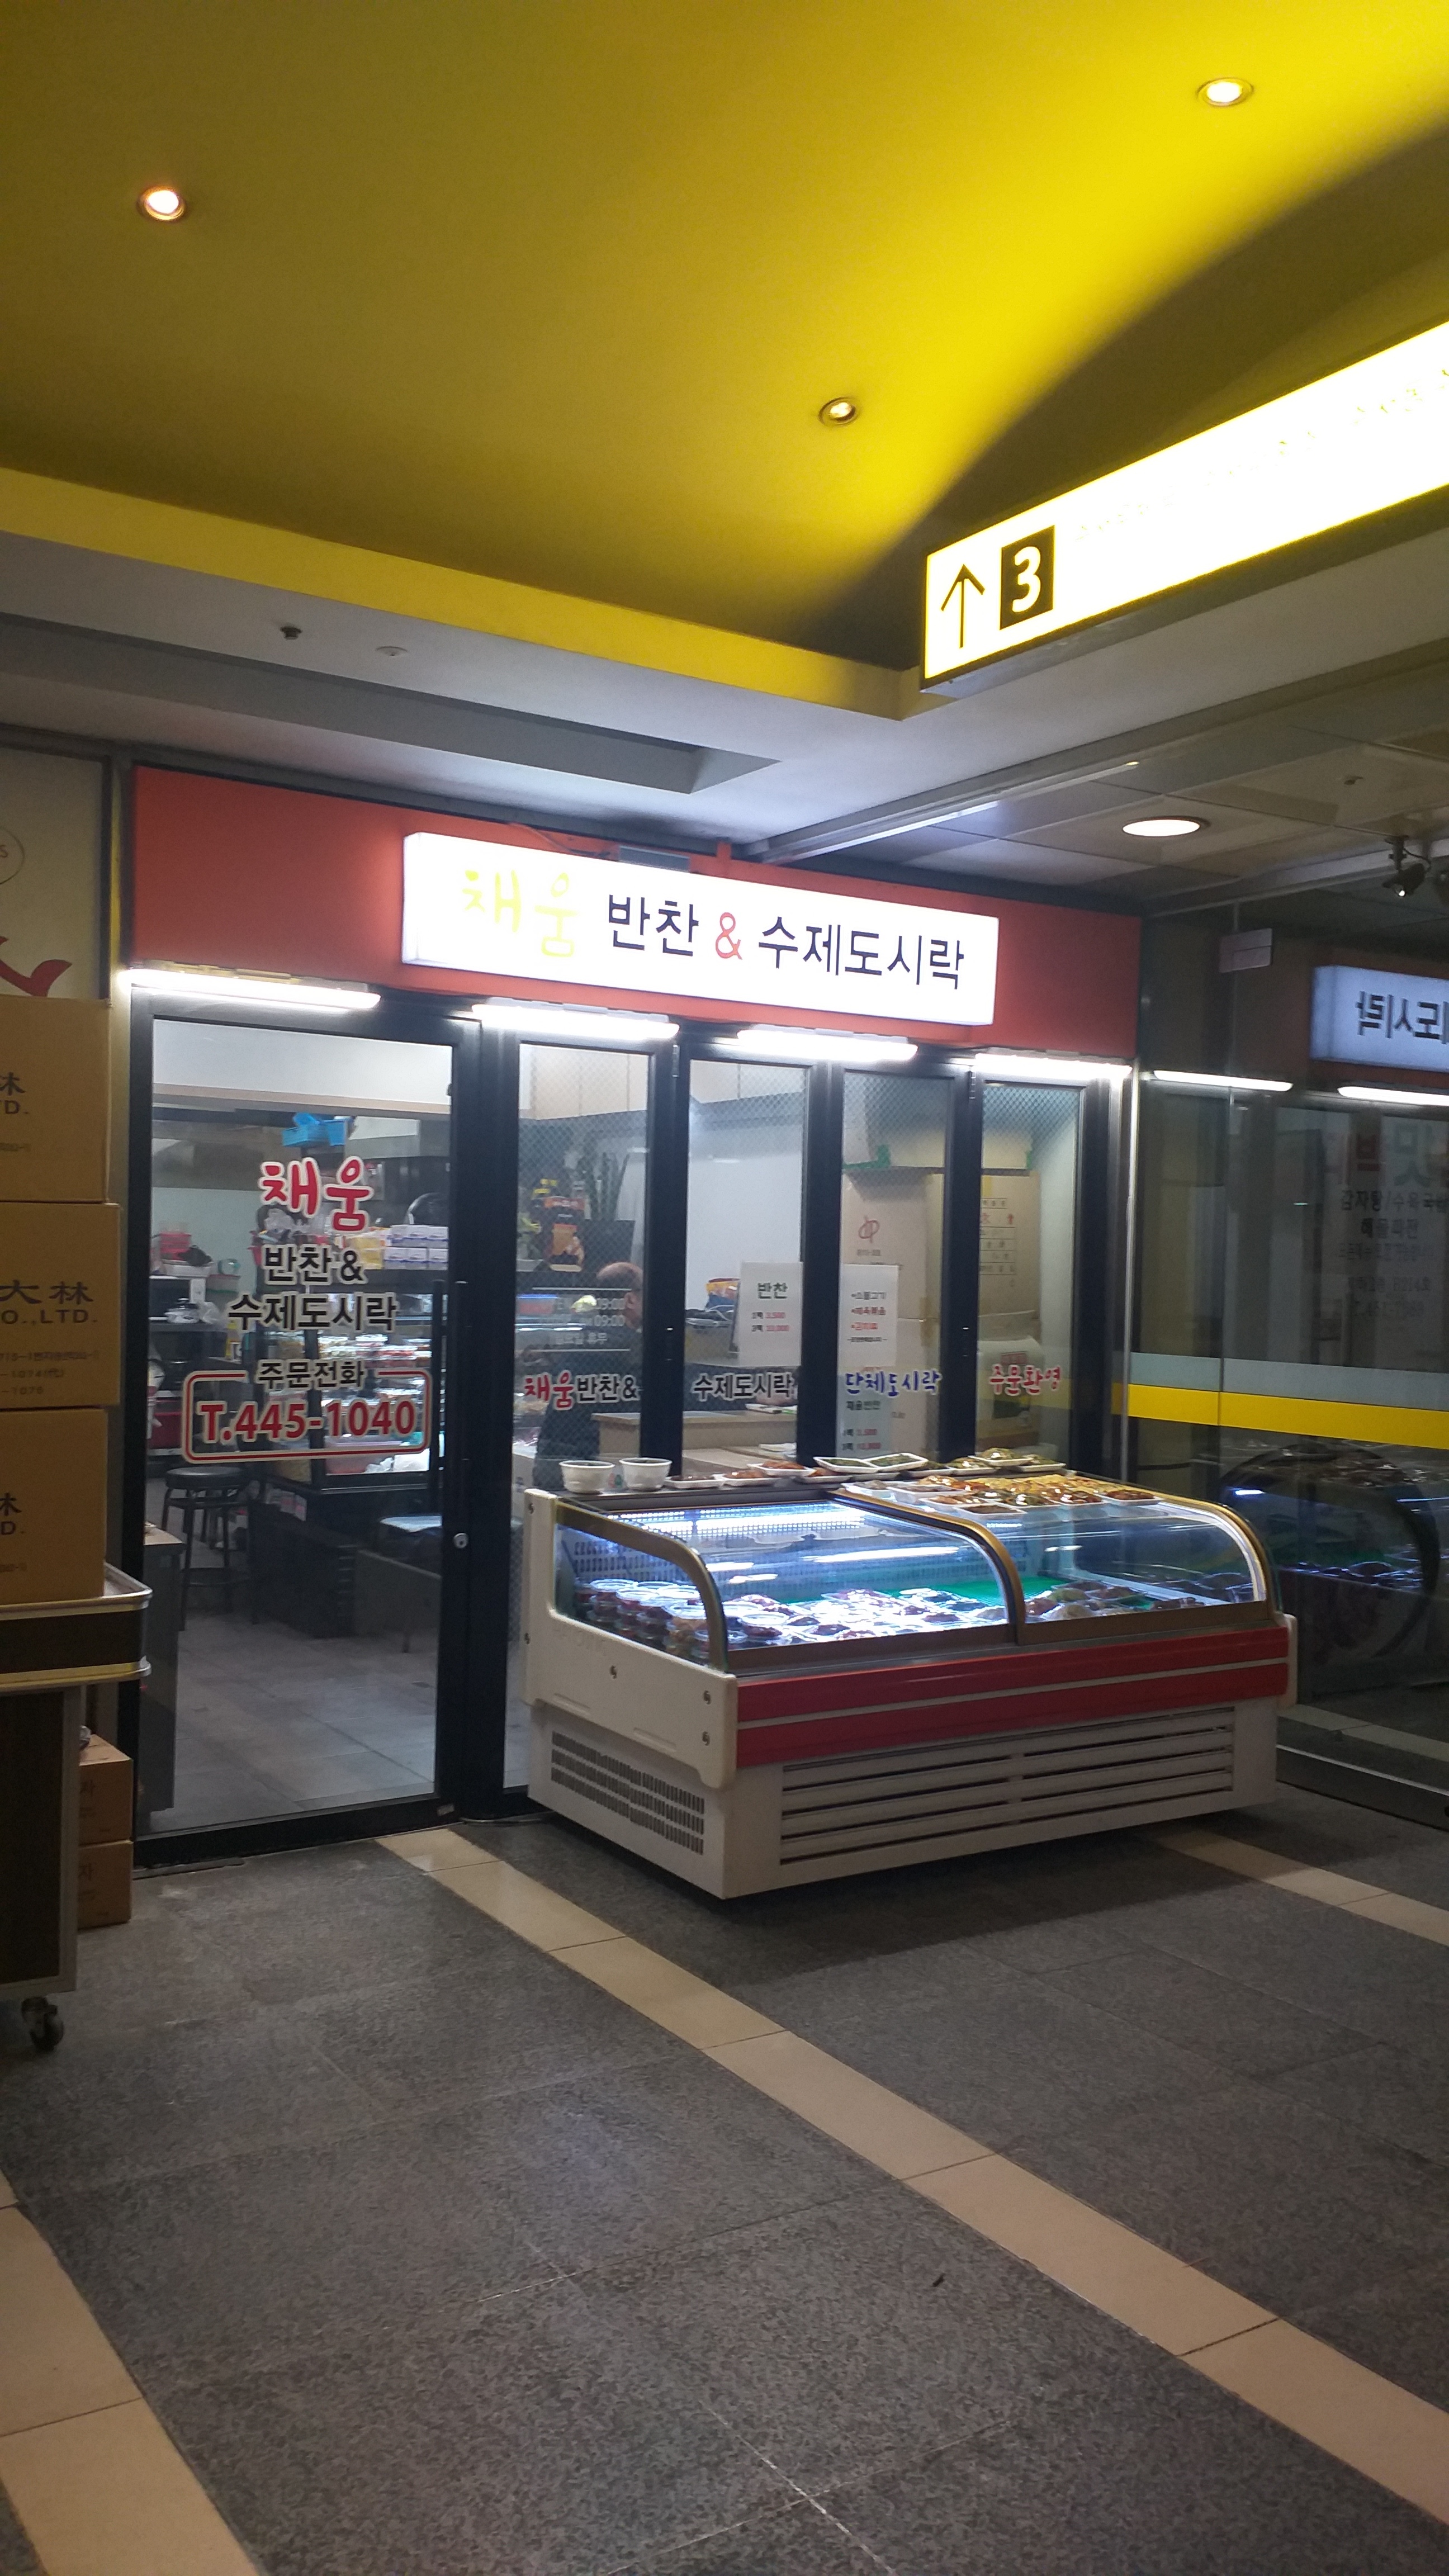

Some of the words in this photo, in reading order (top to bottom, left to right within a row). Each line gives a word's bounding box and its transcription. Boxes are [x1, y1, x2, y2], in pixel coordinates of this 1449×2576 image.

[1012, 546, 1041, 614] 3
[462, 870, 579, 957] 채움
[609, 894, 699, 956] 반찬
[715, 911, 742, 960] &
[757, 916, 964, 990] 수제도시락
[261, 1157, 373, 1232] 채움
[265, 1245, 332, 1283] 반찬
[757, 1282, 788, 1299] 반찬
[228, 1294, 396, 1330] 수제도시락
[257, 1360, 365, 1389] 주문전화
[524, 1371, 573, 1409] 채움
[693, 1372, 793, 1399] 수제도시락
[845, 1370, 941, 1398] 단체도시락
[989, 1365, 1061, 1395] 주문환영
[197, 1400, 415, 1441] T.445-1040
